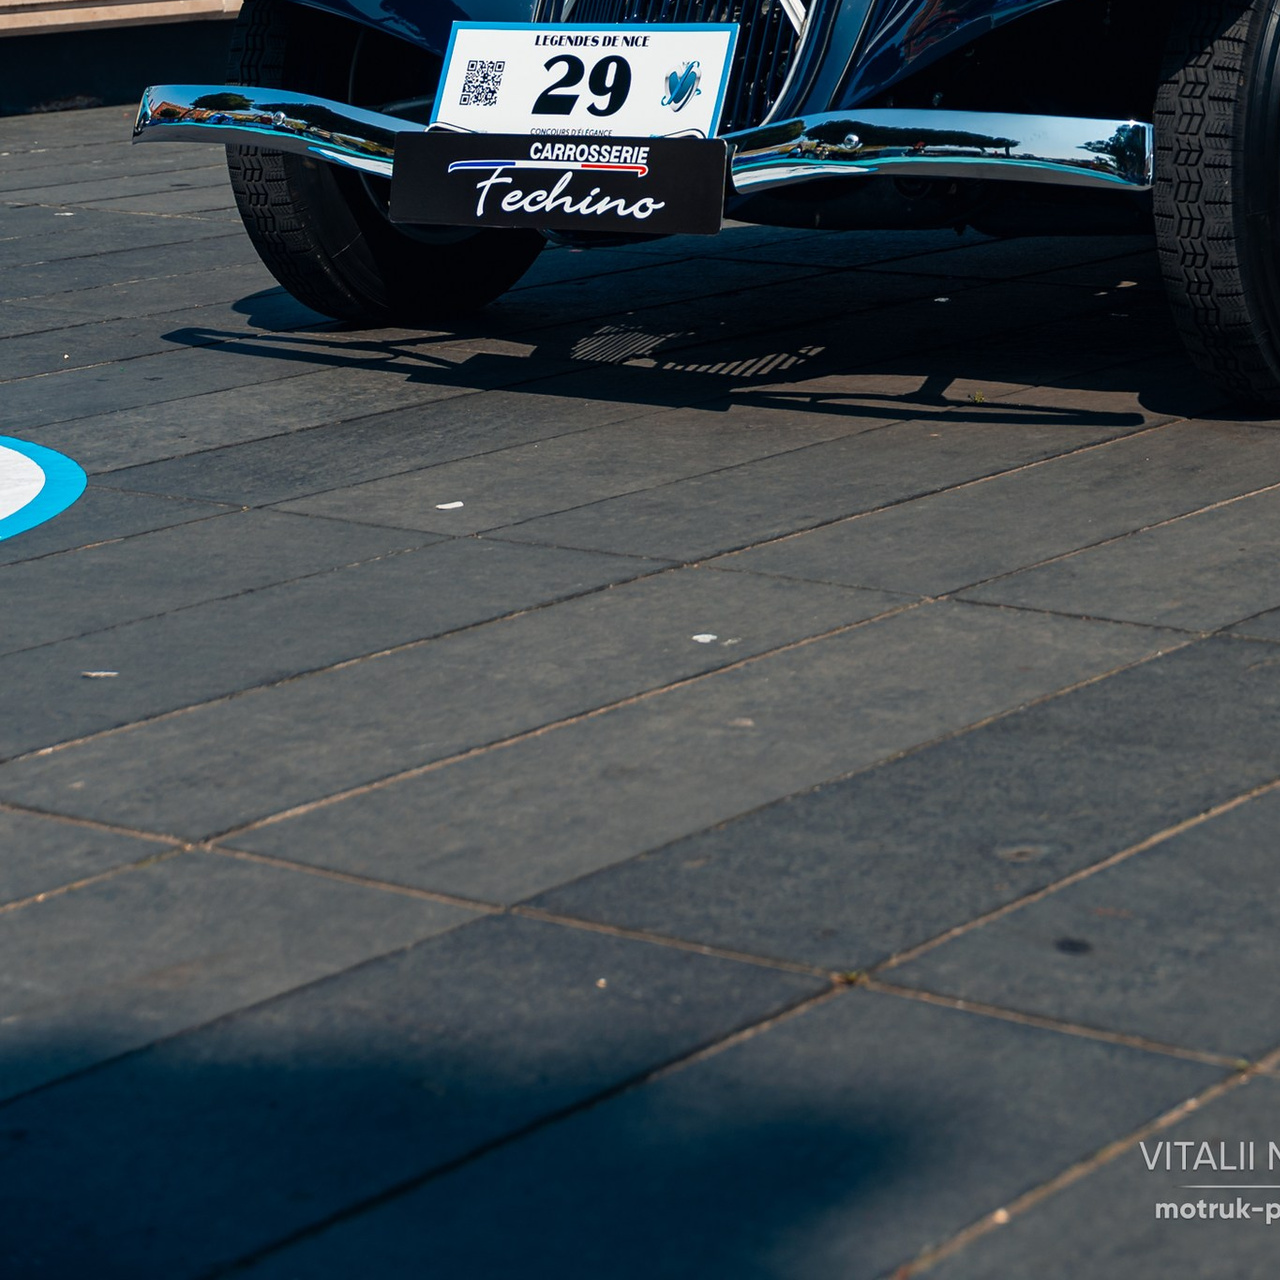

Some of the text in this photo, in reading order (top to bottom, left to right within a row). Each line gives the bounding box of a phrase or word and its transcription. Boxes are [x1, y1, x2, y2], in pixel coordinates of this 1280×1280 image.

[534, 34, 650, 48] LEGENDES DE NICE
[531, 54, 632, 117] 29
[530, 127, 570, 136] CONCOURS
[529, 142, 650, 164] CARROSSERIE
[476, 167, 665, 219] Fechino
